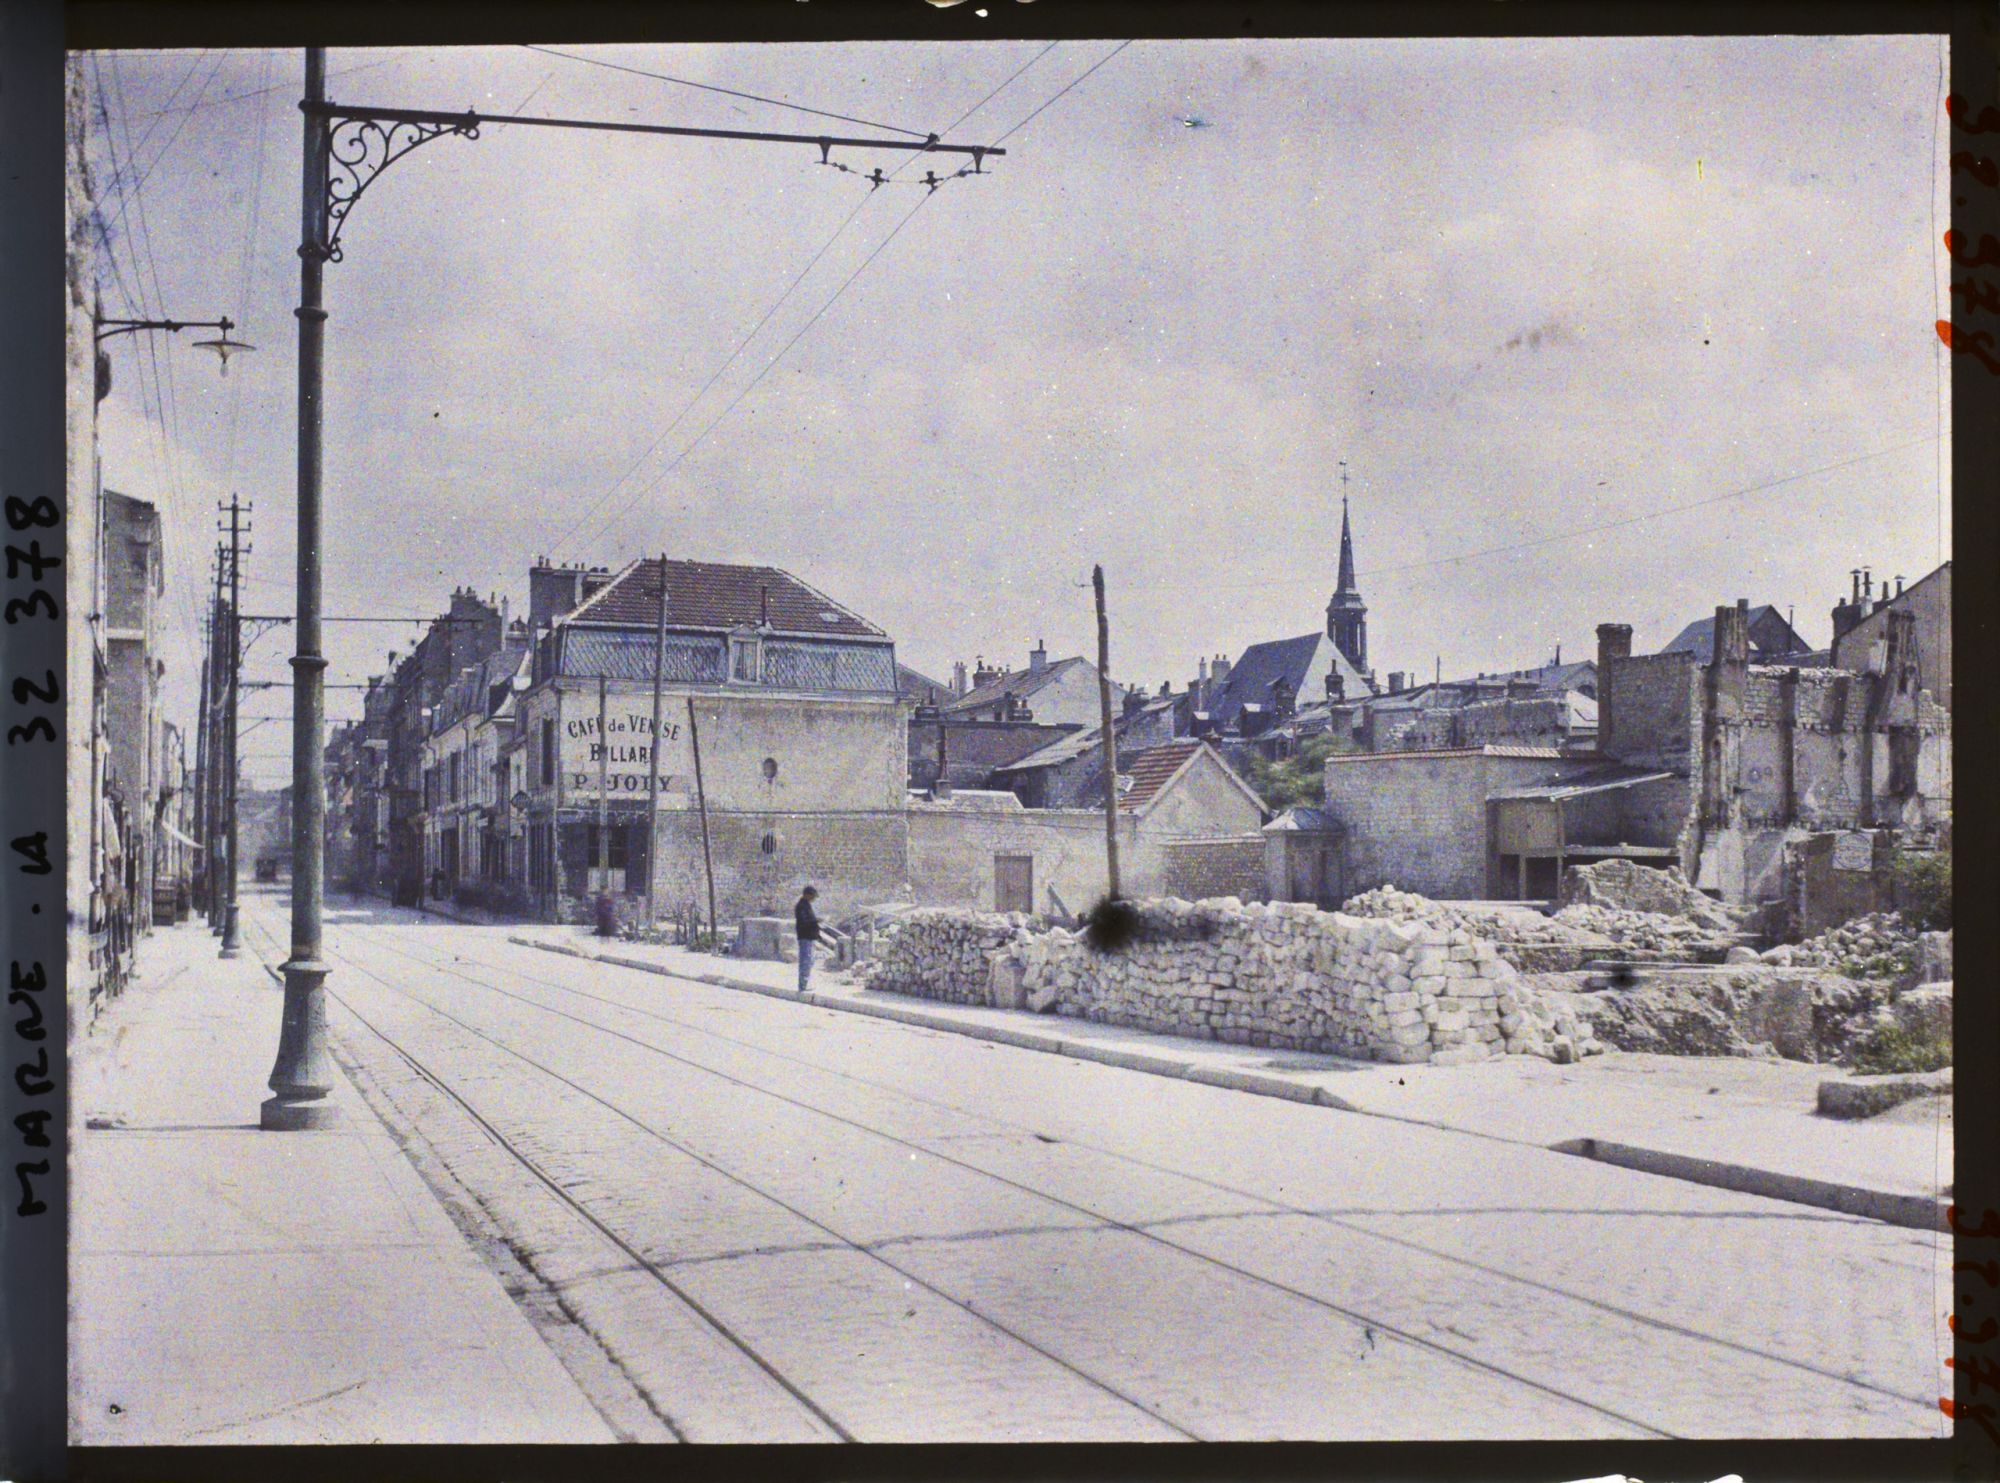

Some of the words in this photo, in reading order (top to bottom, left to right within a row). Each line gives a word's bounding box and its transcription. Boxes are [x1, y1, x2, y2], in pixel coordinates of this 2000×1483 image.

[5, 496, 62, 625] 378
[8, 669, 60, 746] 32
[608, 719, 625, 732] de
[627, 713, 681, 741] VENSE
[589, 743, 657, 763] BLLAR
[9, 961, 56, 1217] MARNE
